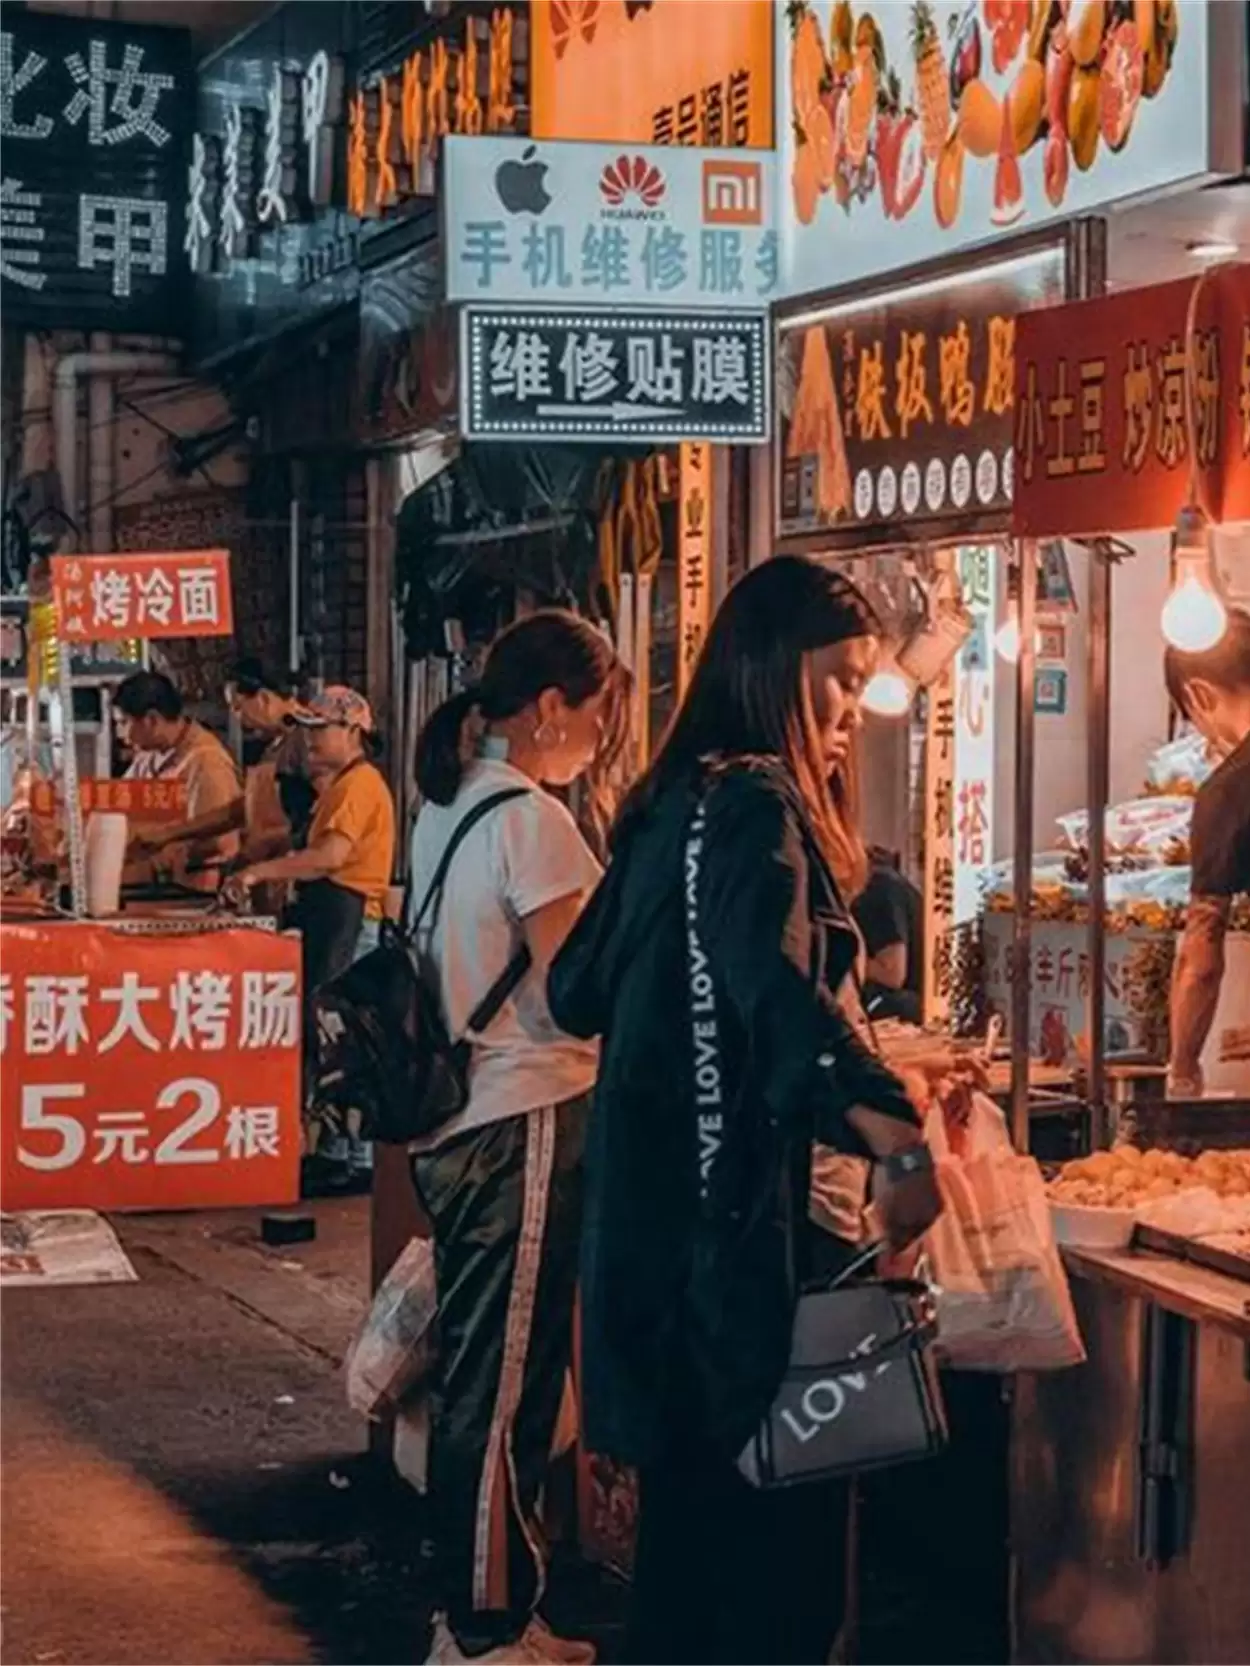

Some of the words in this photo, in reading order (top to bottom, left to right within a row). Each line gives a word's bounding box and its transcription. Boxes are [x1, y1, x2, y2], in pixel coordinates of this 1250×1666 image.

[489, 331, 751, 405] 维修贴膜
[1015, 355, 1107, 478] 小土豆
[1121, 325, 1221, 474] 炒凉粉
[91, 567, 218, 628] 烤冷面
[0, 971, 300, 1054] 酥大烤肠
[693, 1020, 721, 1105] LOVE
[17, 1077, 281, 1171] 5元2根
